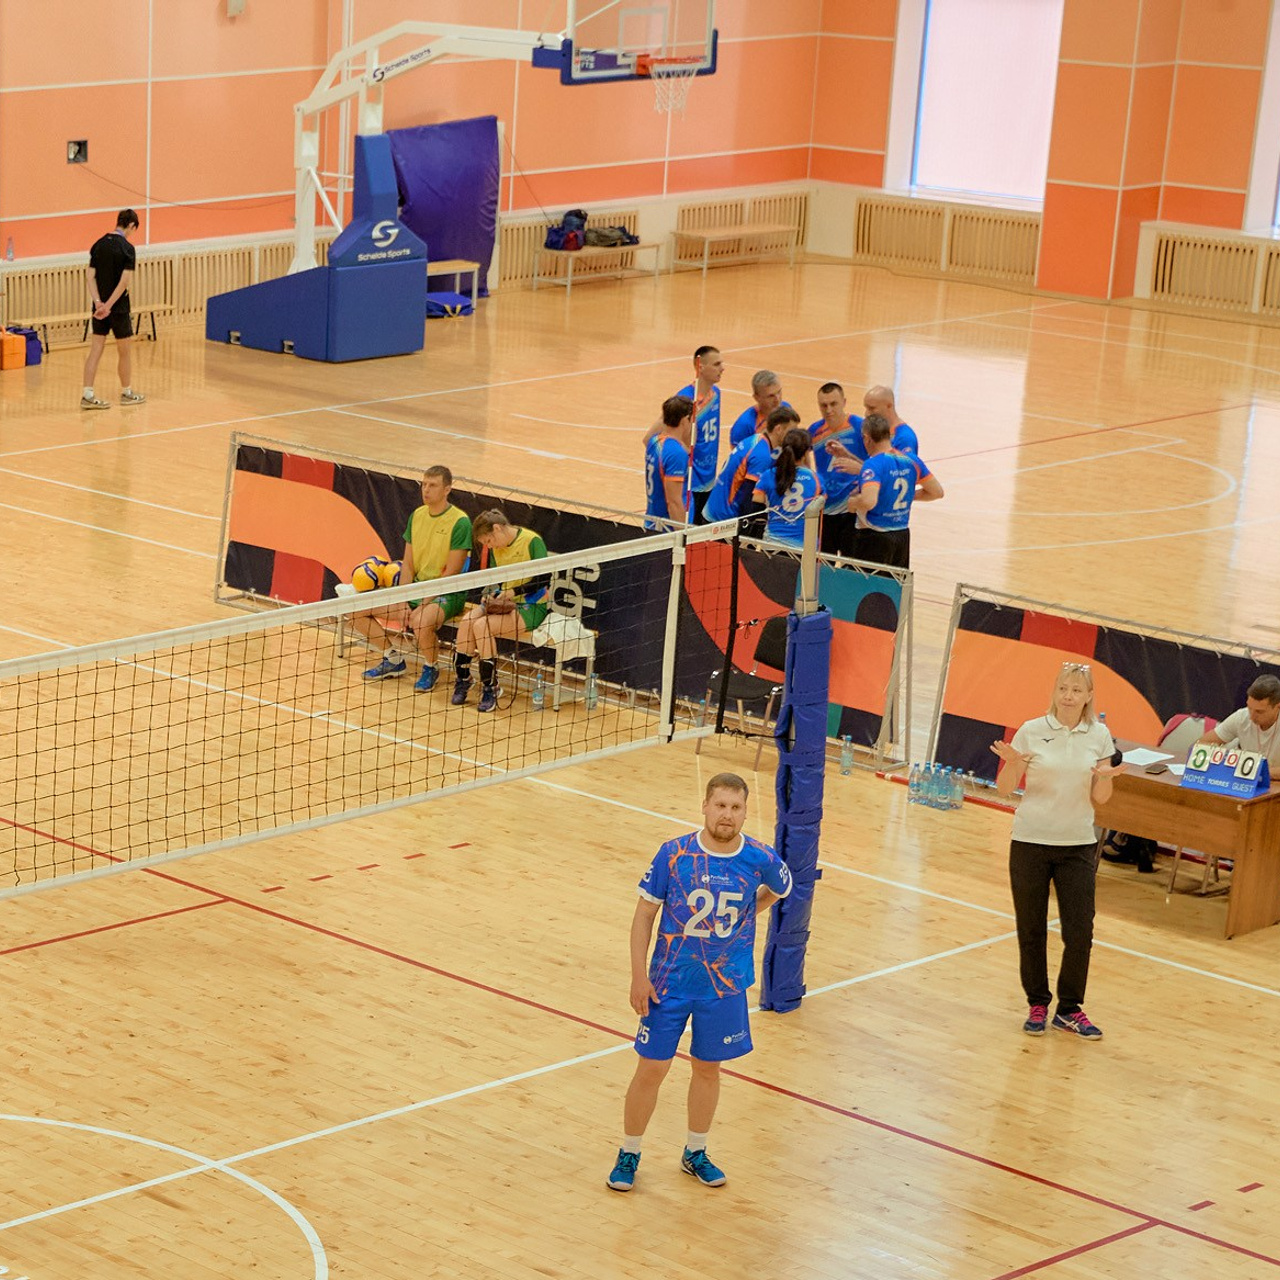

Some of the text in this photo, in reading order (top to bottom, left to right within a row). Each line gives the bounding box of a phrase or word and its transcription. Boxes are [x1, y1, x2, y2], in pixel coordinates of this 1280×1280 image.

[357, 248, 411, 262] Schelde Sports
[702, 417, 718, 443] 15
[782, 482, 804, 512] 8
[892, 477, 909, 510] 2
[1183, 773, 1206, 785] HOME
[1231, 782, 1255, 792] GUEST
[683, 888, 744, 938] 25
